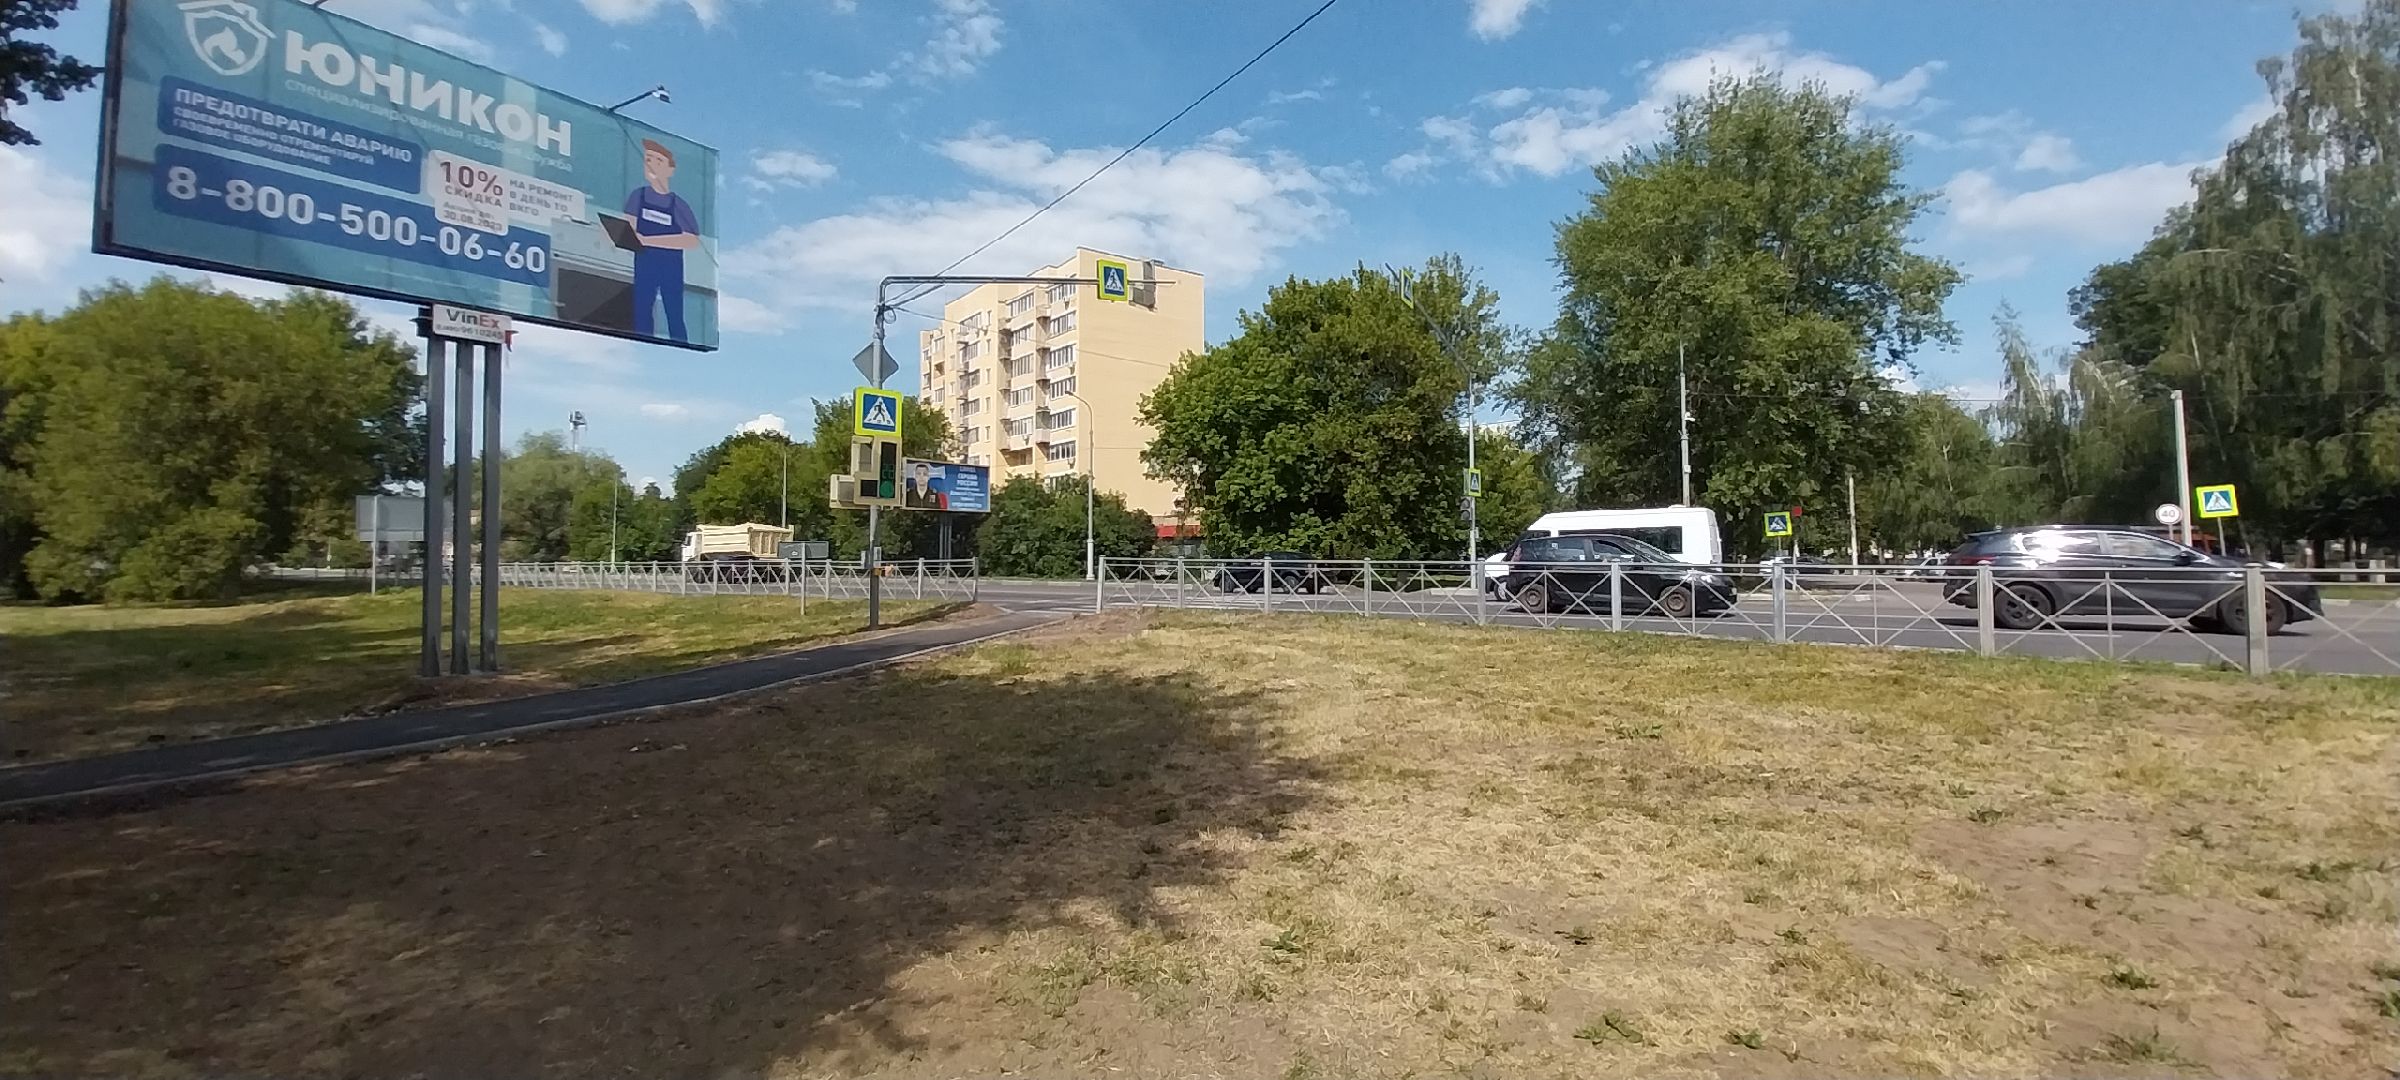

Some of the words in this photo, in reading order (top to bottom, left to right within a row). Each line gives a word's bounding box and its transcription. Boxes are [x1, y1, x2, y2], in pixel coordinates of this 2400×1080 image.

[284, 29, 572, 157] ЮНИКОН
[173, 106, 278, 141] СВОЕВРЕМЕННО
[175, 88, 326, 140] ПРЕДОТВРАТИ
[330, 131, 413, 163] АВАРИЮ
[173, 118, 231, 141] ГАЗОВОЕ
[233, 133, 331, 166] ОБОРУДОВАНИЕ
[440, 161, 503, 197] 10%
[509, 179, 527, 190] НА
[528, 184, 574, 202] РЕМОНТ
[444, 185, 503, 209] СКИДКА
[509, 190, 518, 199] В
[520, 192, 552, 209] ДЕНЬ
[166, 165, 546, 273] 8-800-500-06-60
[446, 308, 501, 329] VinEx
[2160, 509, 2176, 518] 40
